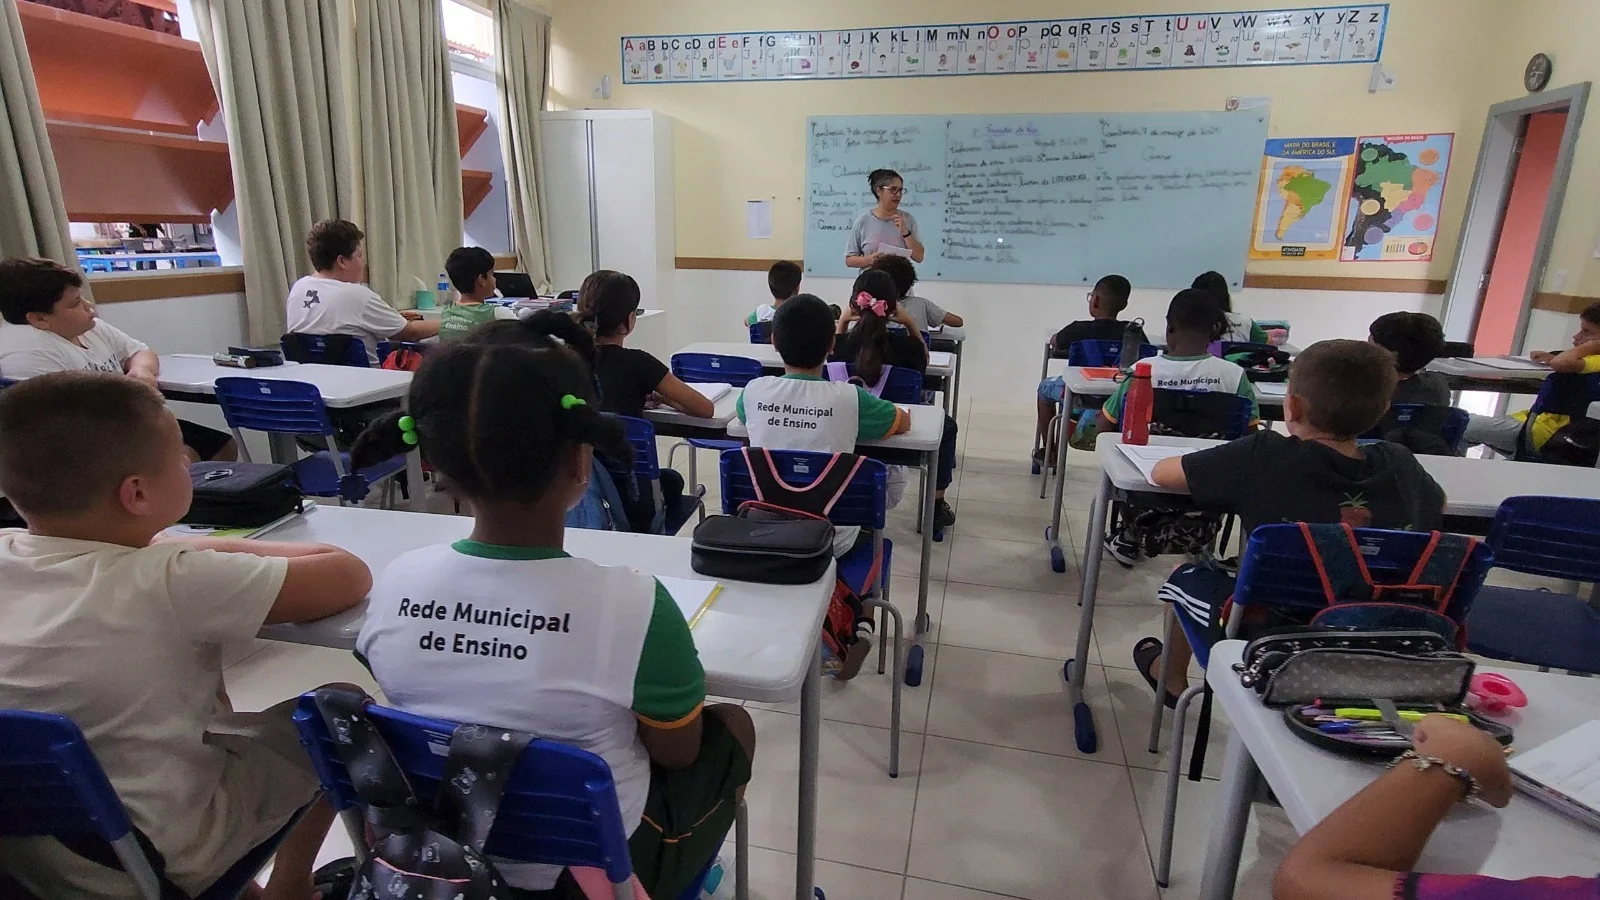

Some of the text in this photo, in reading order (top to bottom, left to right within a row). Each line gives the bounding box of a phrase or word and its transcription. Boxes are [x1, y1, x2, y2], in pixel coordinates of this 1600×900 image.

[625, 38, 634, 51] A
[640, 41, 646, 50] a
[648, 40, 655, 50] B
[662, 40, 669, 50] b
[672, 39, 680, 50] C
[685, 41, 692, 50] c
[692, 39, 701, 49] D
[708, 38, 716, 49] d
[718, 36, 726, 48] E
[732, 40, 739, 48] e
[743, 36, 750, 48] F
[759, 36, 764, 47] f
[766, 36, 776, 47] G
[808, 34, 816, 45] h
[844, 33, 850, 44] J
[860, 32, 864, 44] j
[870, 32, 880, 43] K
[891, 31, 898, 42] k
[902, 31, 908, 42] L
[927, 29, 938, 41] M
[947, 31, 958, 40] m
[960, 28, 970, 40] N
[978, 30, 985, 39] n
[988, 26, 999, 39] O
[1007, 28, 1016, 38] o
[1019, 26, 1027, 37] P
[1040, 27, 1050, 39] p
[1050, 24, 1062, 36] Q
[1068, 25, 1077, 37] q
[1081, 23, 1091, 35] R
[1101, 25, 1107, 34] r
[1111, 22, 1120, 34] S
[1131, 23, 1138, 33] s
[1145, 20, 1154, 32] T
[1166, 19, 1171, 31] t
[1177, 17, 1189, 30] U
[1198, 20, 1206, 30] u
[1211, 17, 1221, 29] V
[1233, 19, 1241, 28] v
[1242, 15, 1257, 28] W
[1303, 16, 1312, 24] x
[1315, 12, 1325, 24] Y
[1336, 12, 1346, 24] y
[1348, 10, 1360, 23] Z
[1369, 13, 1379, 22] z
[446, 322, 468, 330] Ensino
[758, 402, 833, 418] Rede Municipal
[768, 417, 817, 429] de Ensino
[398, 598, 570, 634] Rede Municipal
[419, 631, 528, 660] de Ensino
